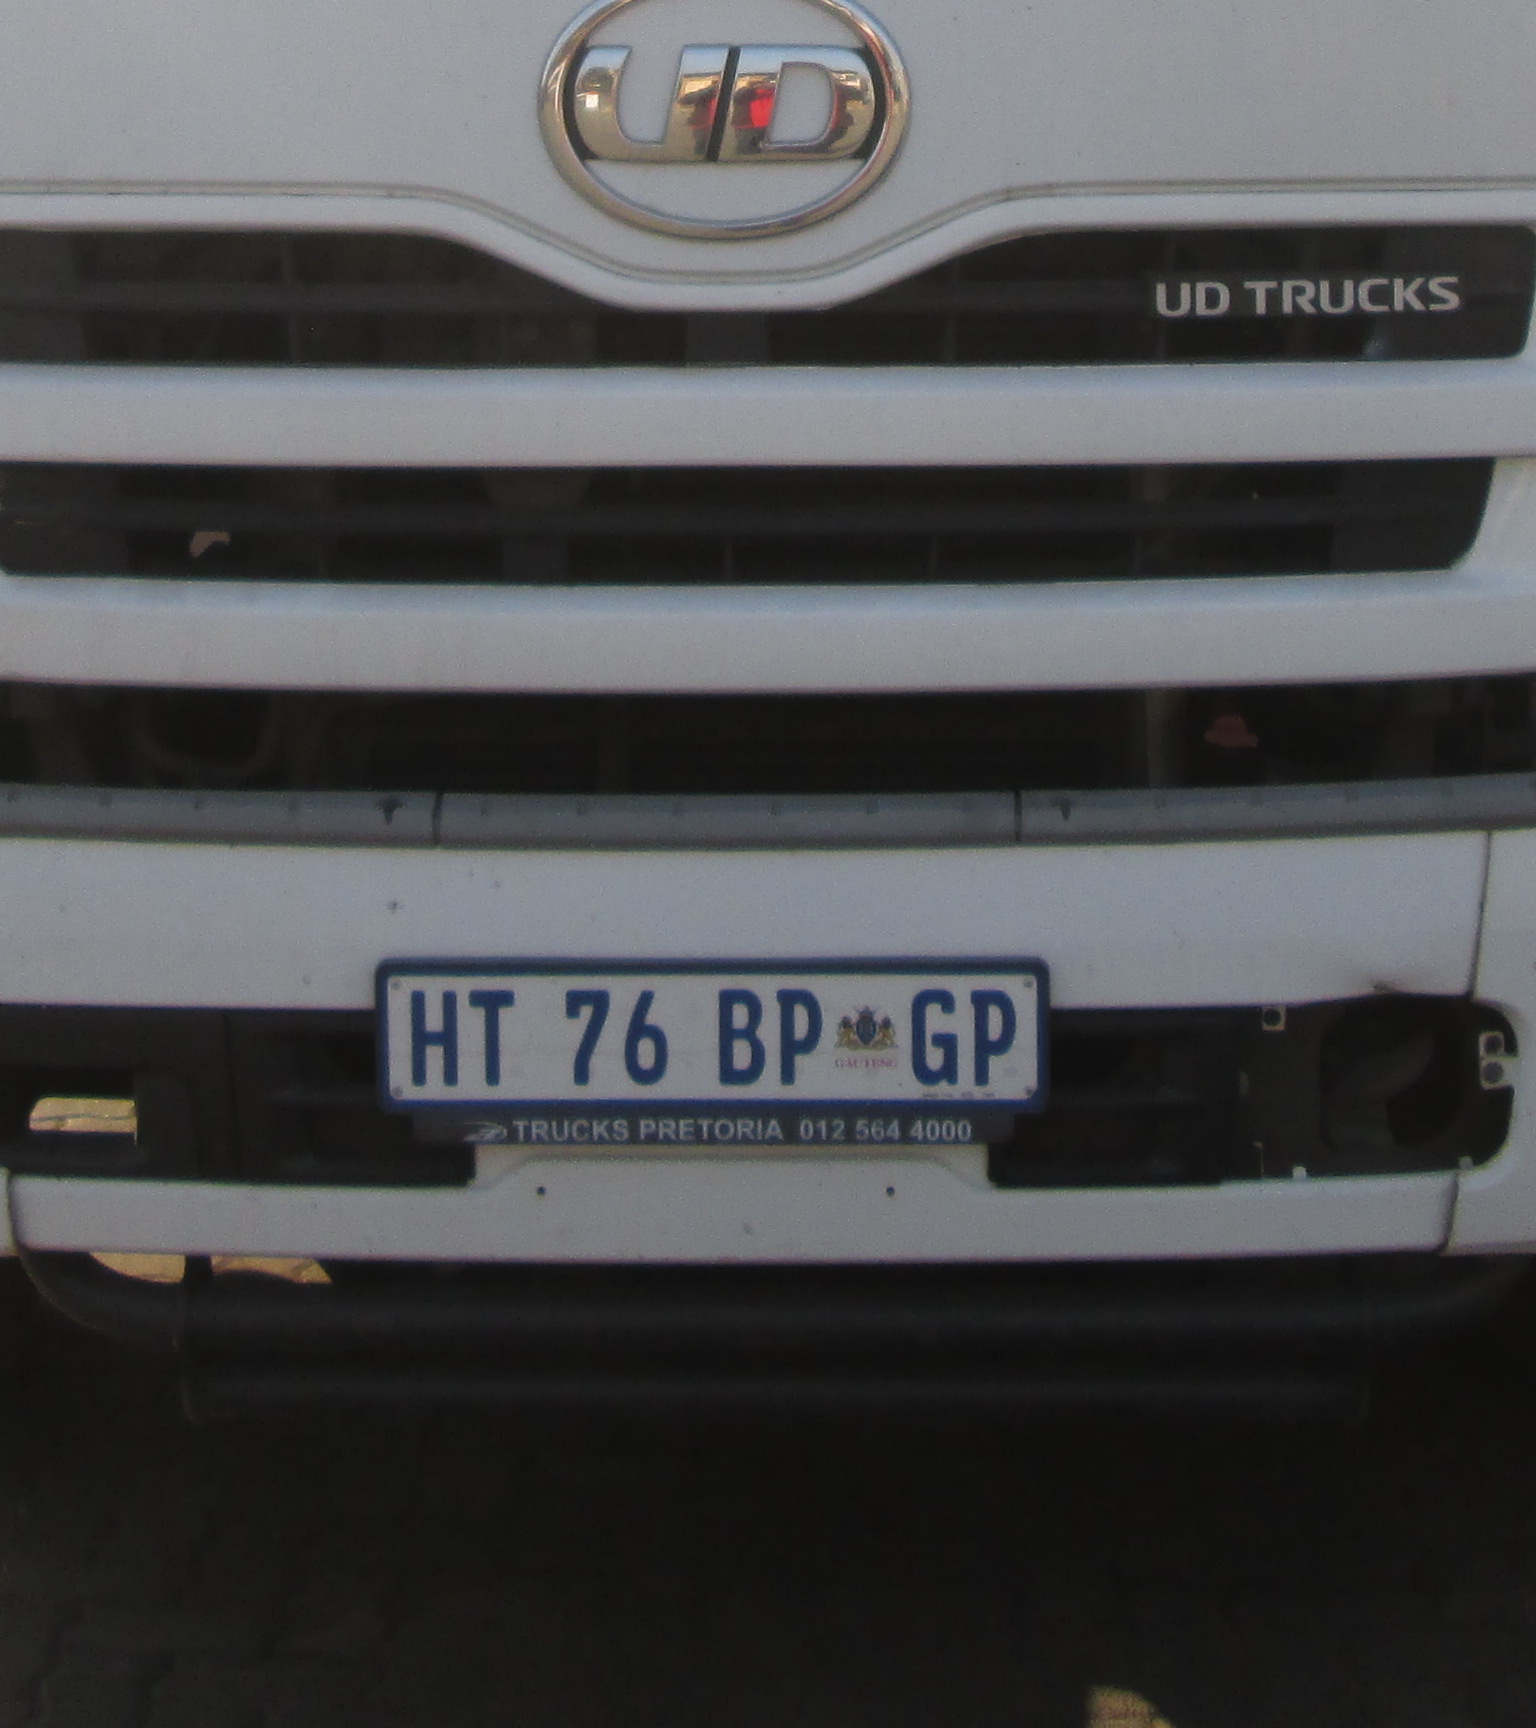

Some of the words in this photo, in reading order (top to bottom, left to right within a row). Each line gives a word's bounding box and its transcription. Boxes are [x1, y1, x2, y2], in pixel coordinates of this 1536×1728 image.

[574, 44, 877, 161] UD
[1154, 281, 1231, 317] UD
[1243, 275, 1462, 315] TRUCKS
[409, 988, 515, 1087] HT
[565, 988, 669, 1087] 76
[717, 987, 824, 1087] BP
[910, 987, 1017, 1087] GP
[512, 1117, 630, 1142] TRUCKS
[639, 1117, 784, 1141] PRETORIA
[799, 1117, 845, 1141] 012
[855, 1118, 901, 1142] 564
[909, 1118, 972, 1142] 4000
